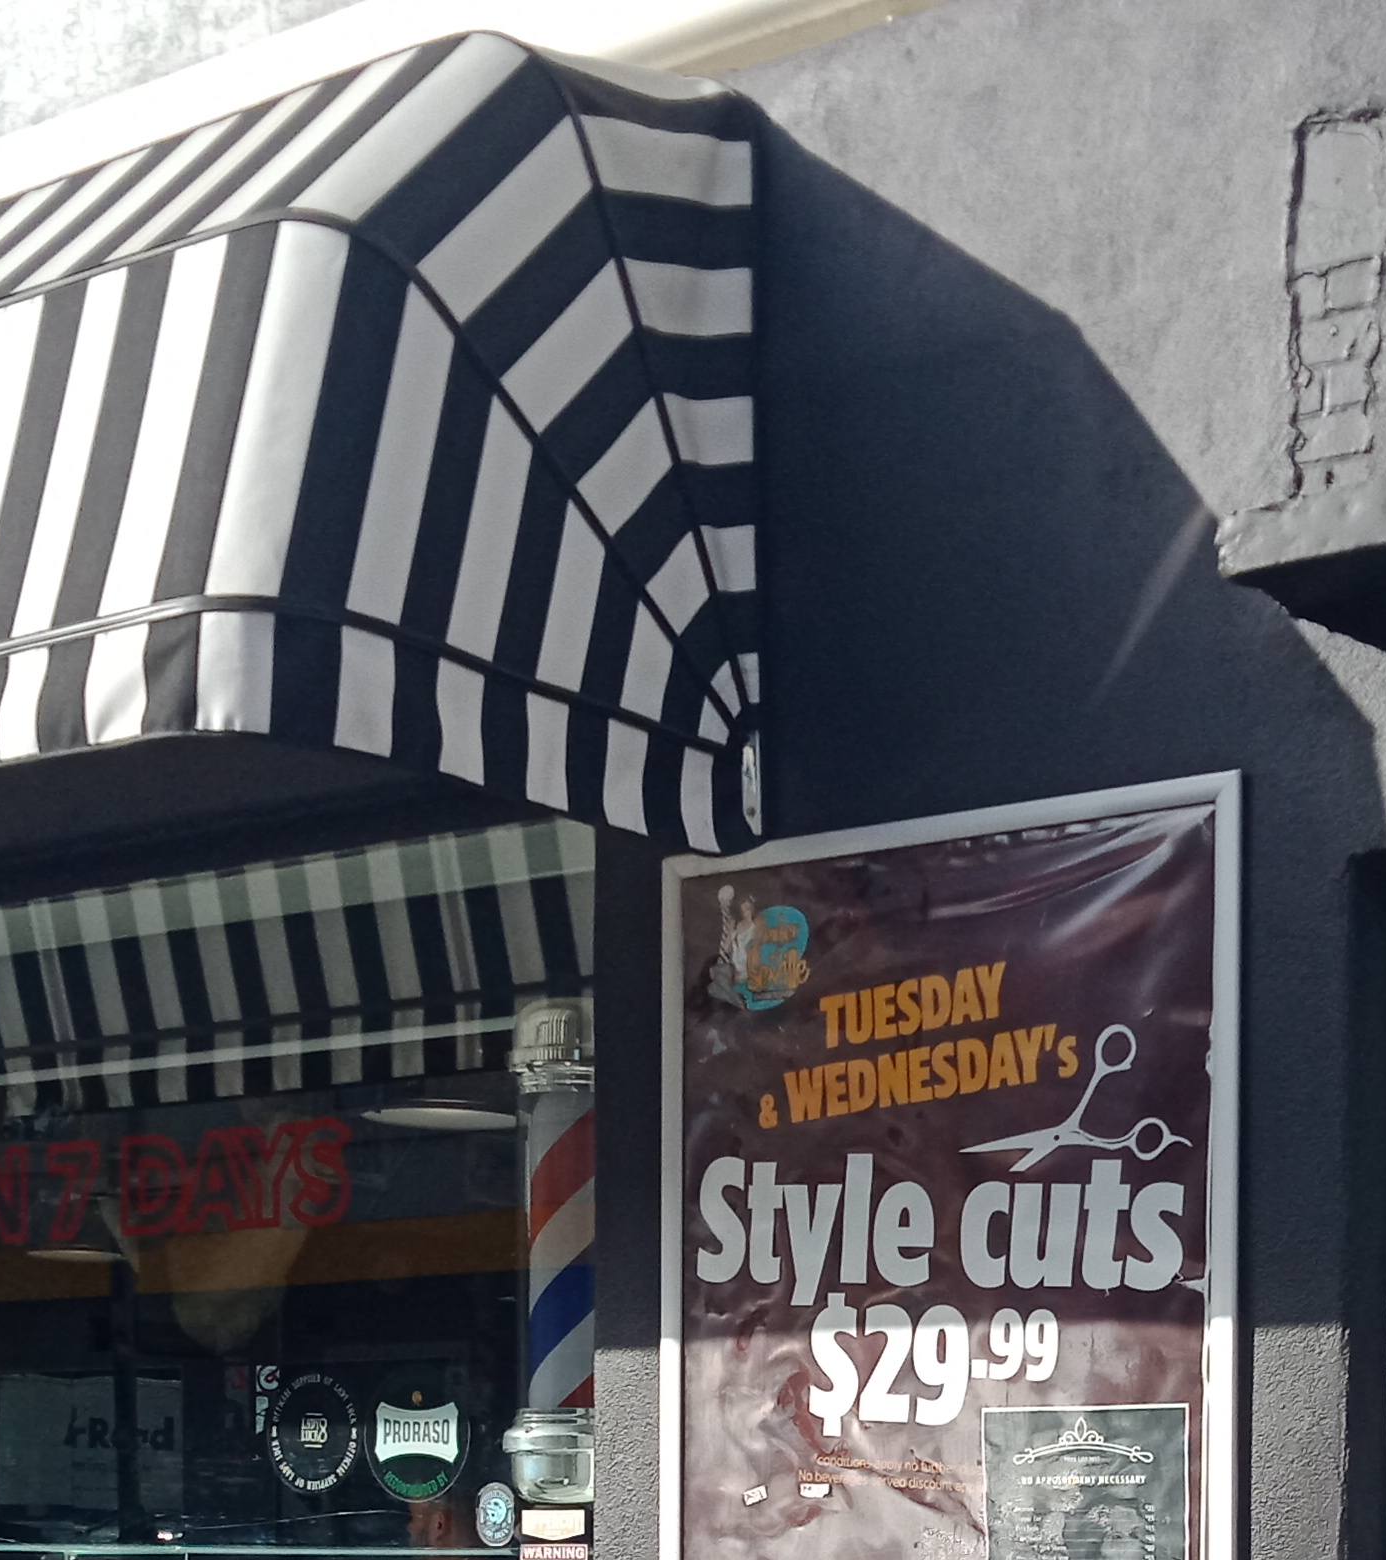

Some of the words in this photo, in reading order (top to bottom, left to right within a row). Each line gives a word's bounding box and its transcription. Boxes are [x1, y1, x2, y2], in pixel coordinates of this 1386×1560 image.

[819, 961, 1006, 1049] TUESDAY
[759, 1093, 779, 1129] &
[783, 1023, 1080, 1124] WEDNESDAY's
[44, 1140, 100, 1242] 7
[120, 1117, 353, 1236] DAYS
[696, 1153, 935, 1306] Style
[960, 1159, 1186, 1291] cuts
[808, 1292, 1060, 1437] $29.99
[383, 1418, 450, 1445] PRORASO
[798, 1469, 815, 1482] No
[908, 1477, 954, 1492] discount
[1097, 1474, 1147, 1486] NECESSARY
[523, 1546, 585, 1560] WARNING
